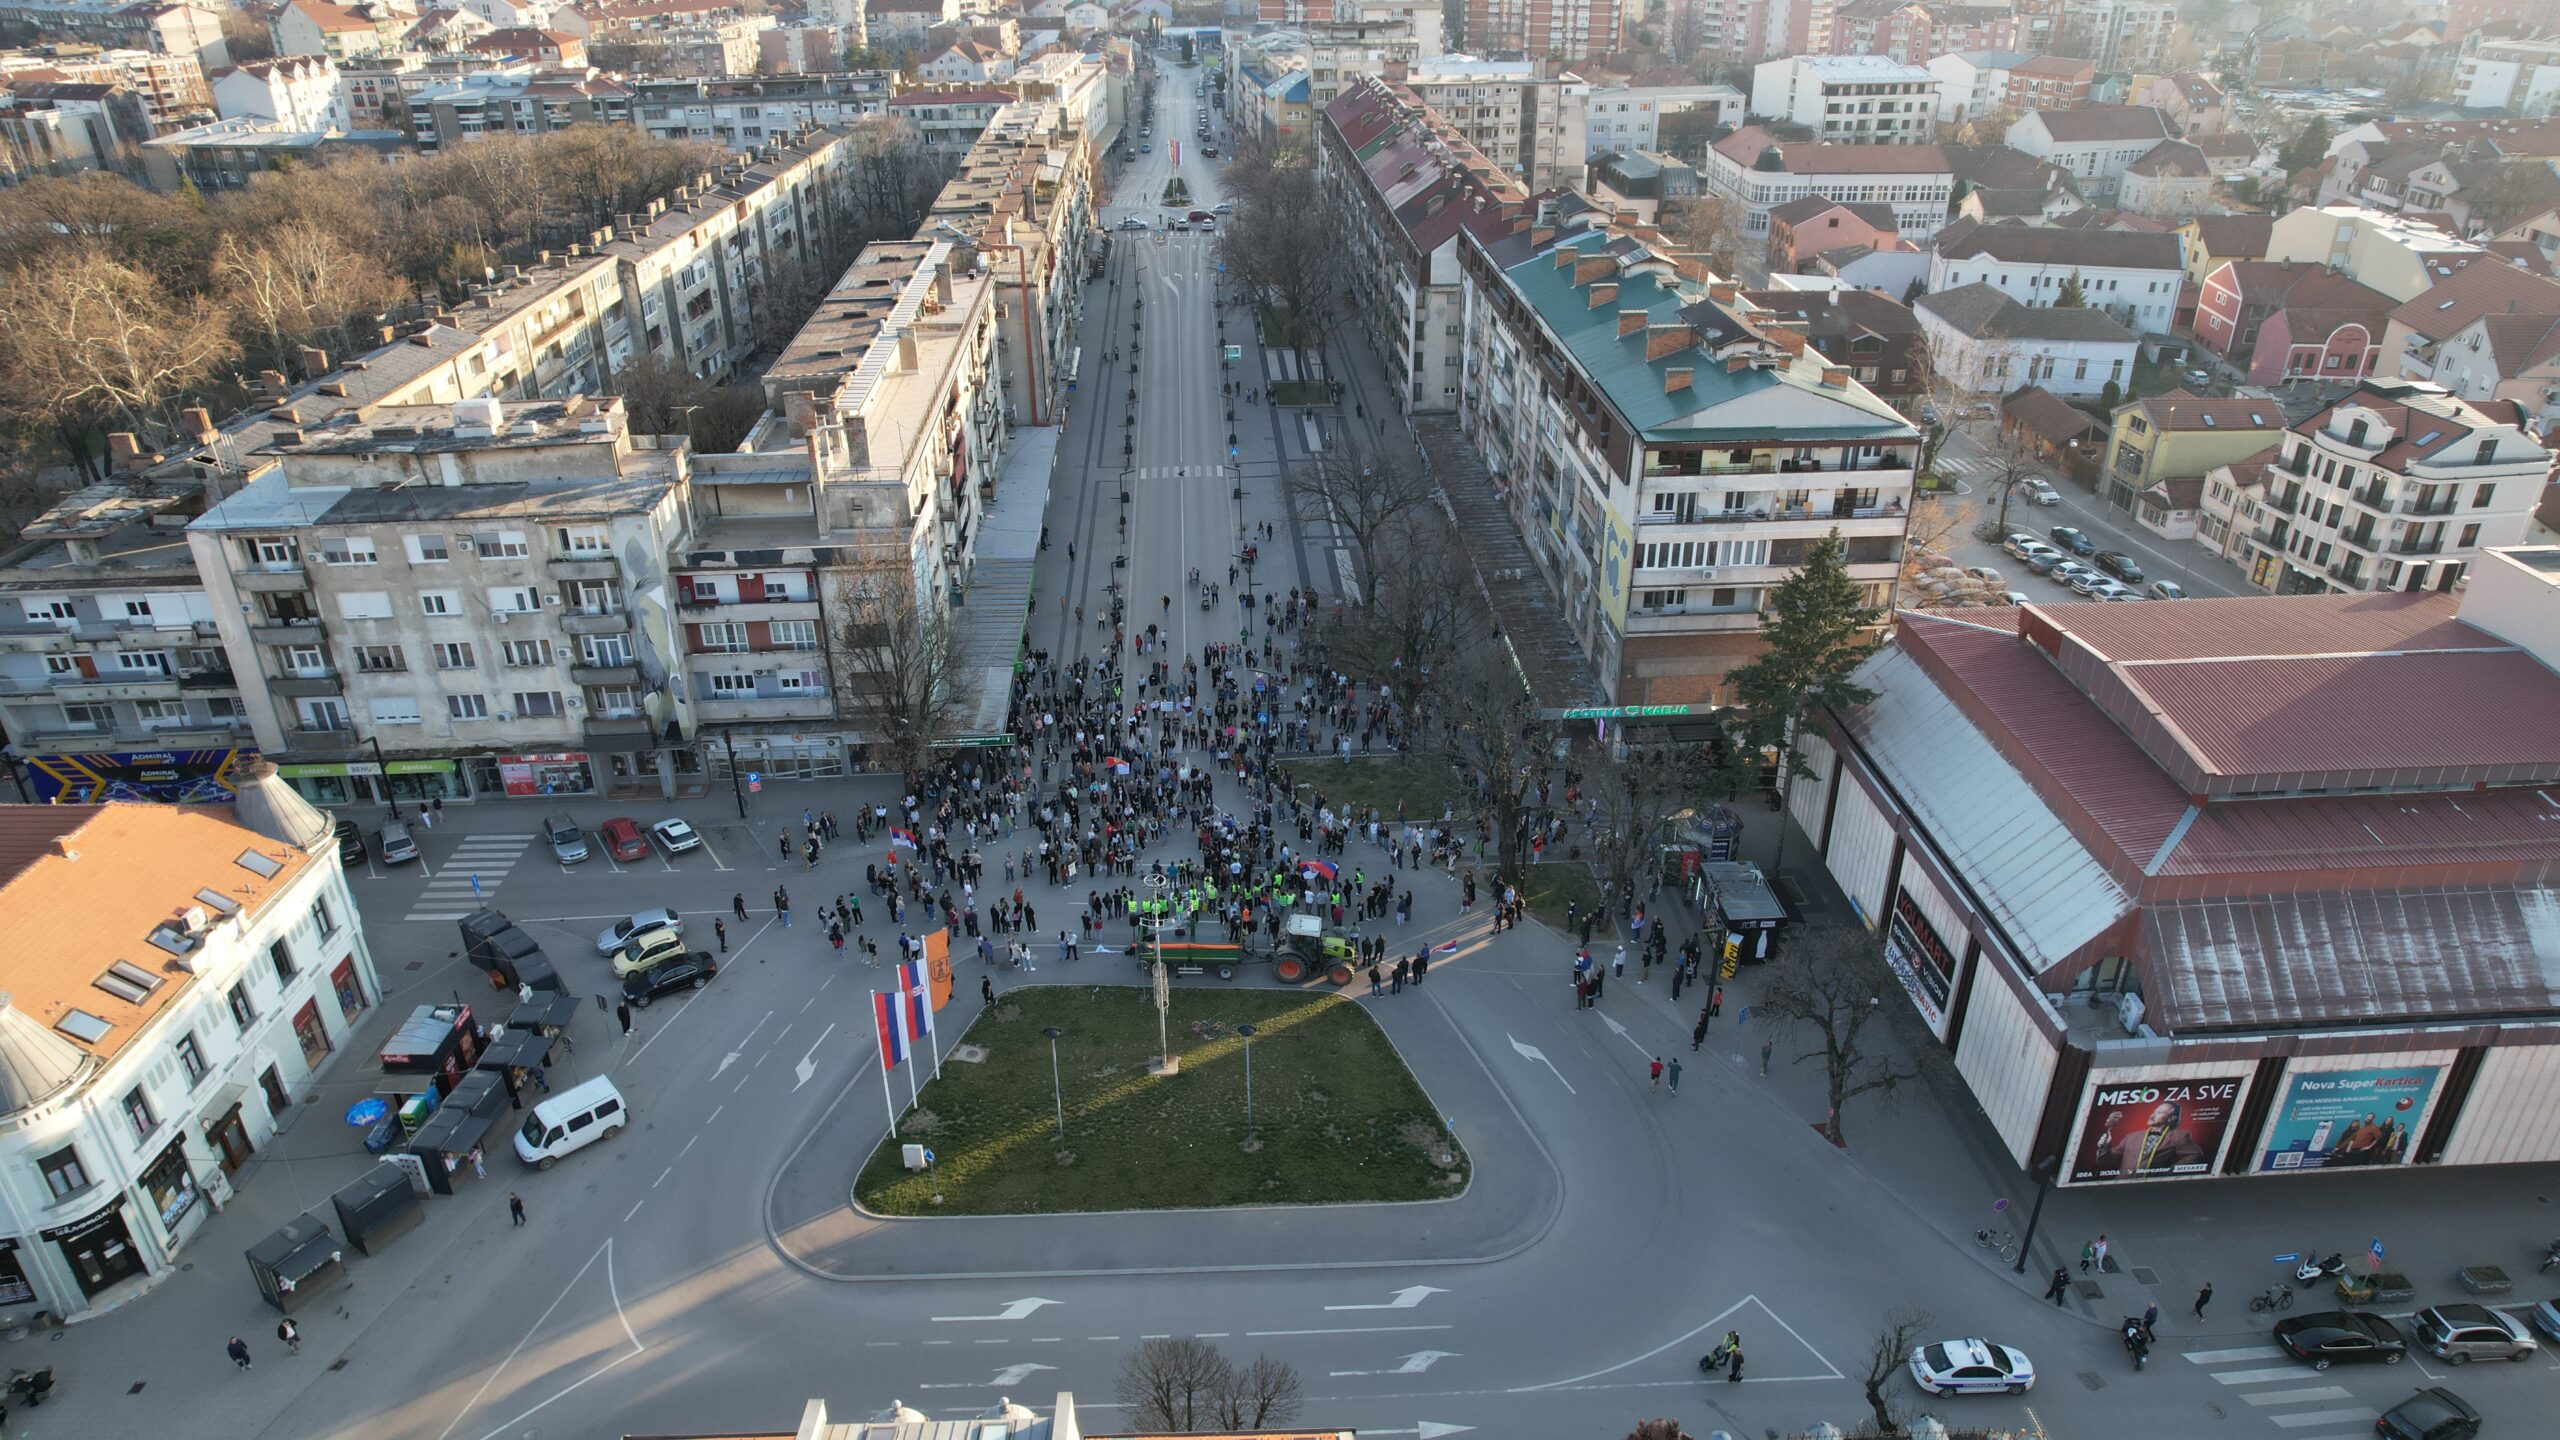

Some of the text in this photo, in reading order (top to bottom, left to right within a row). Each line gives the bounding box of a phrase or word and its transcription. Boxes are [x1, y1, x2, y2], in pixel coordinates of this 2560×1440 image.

[131, 752, 175, 761] ADMIRAL
[1922, 966, 1944, 1001] VISION
[2301, 1080, 2336, 1091] Nova
[2164, 1087, 2190, 1102] ZA
[2196, 1084, 2236, 1100] SVE
